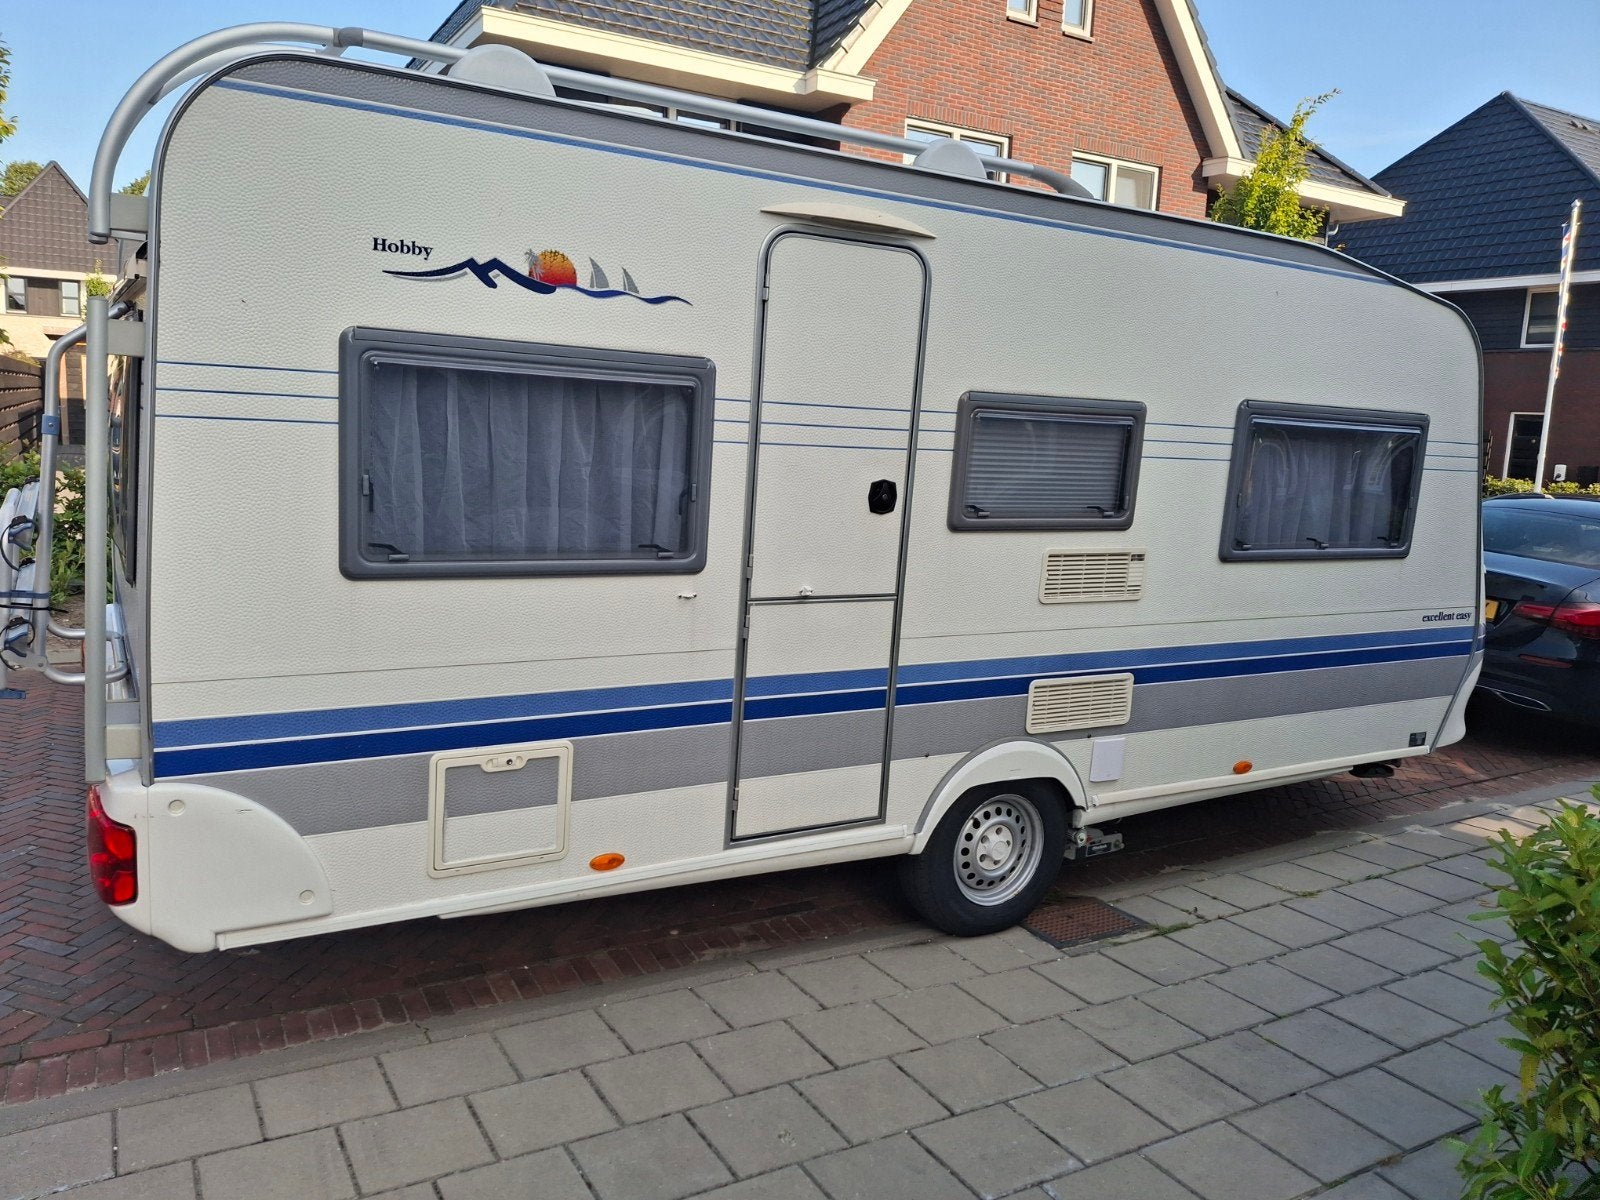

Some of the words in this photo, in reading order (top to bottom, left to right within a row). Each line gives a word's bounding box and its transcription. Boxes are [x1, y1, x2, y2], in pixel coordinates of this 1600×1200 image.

[372, 236, 434, 261] Hobby
[1421, 611, 1455, 622] excellent
[1455, 611, 1472, 621] easy
